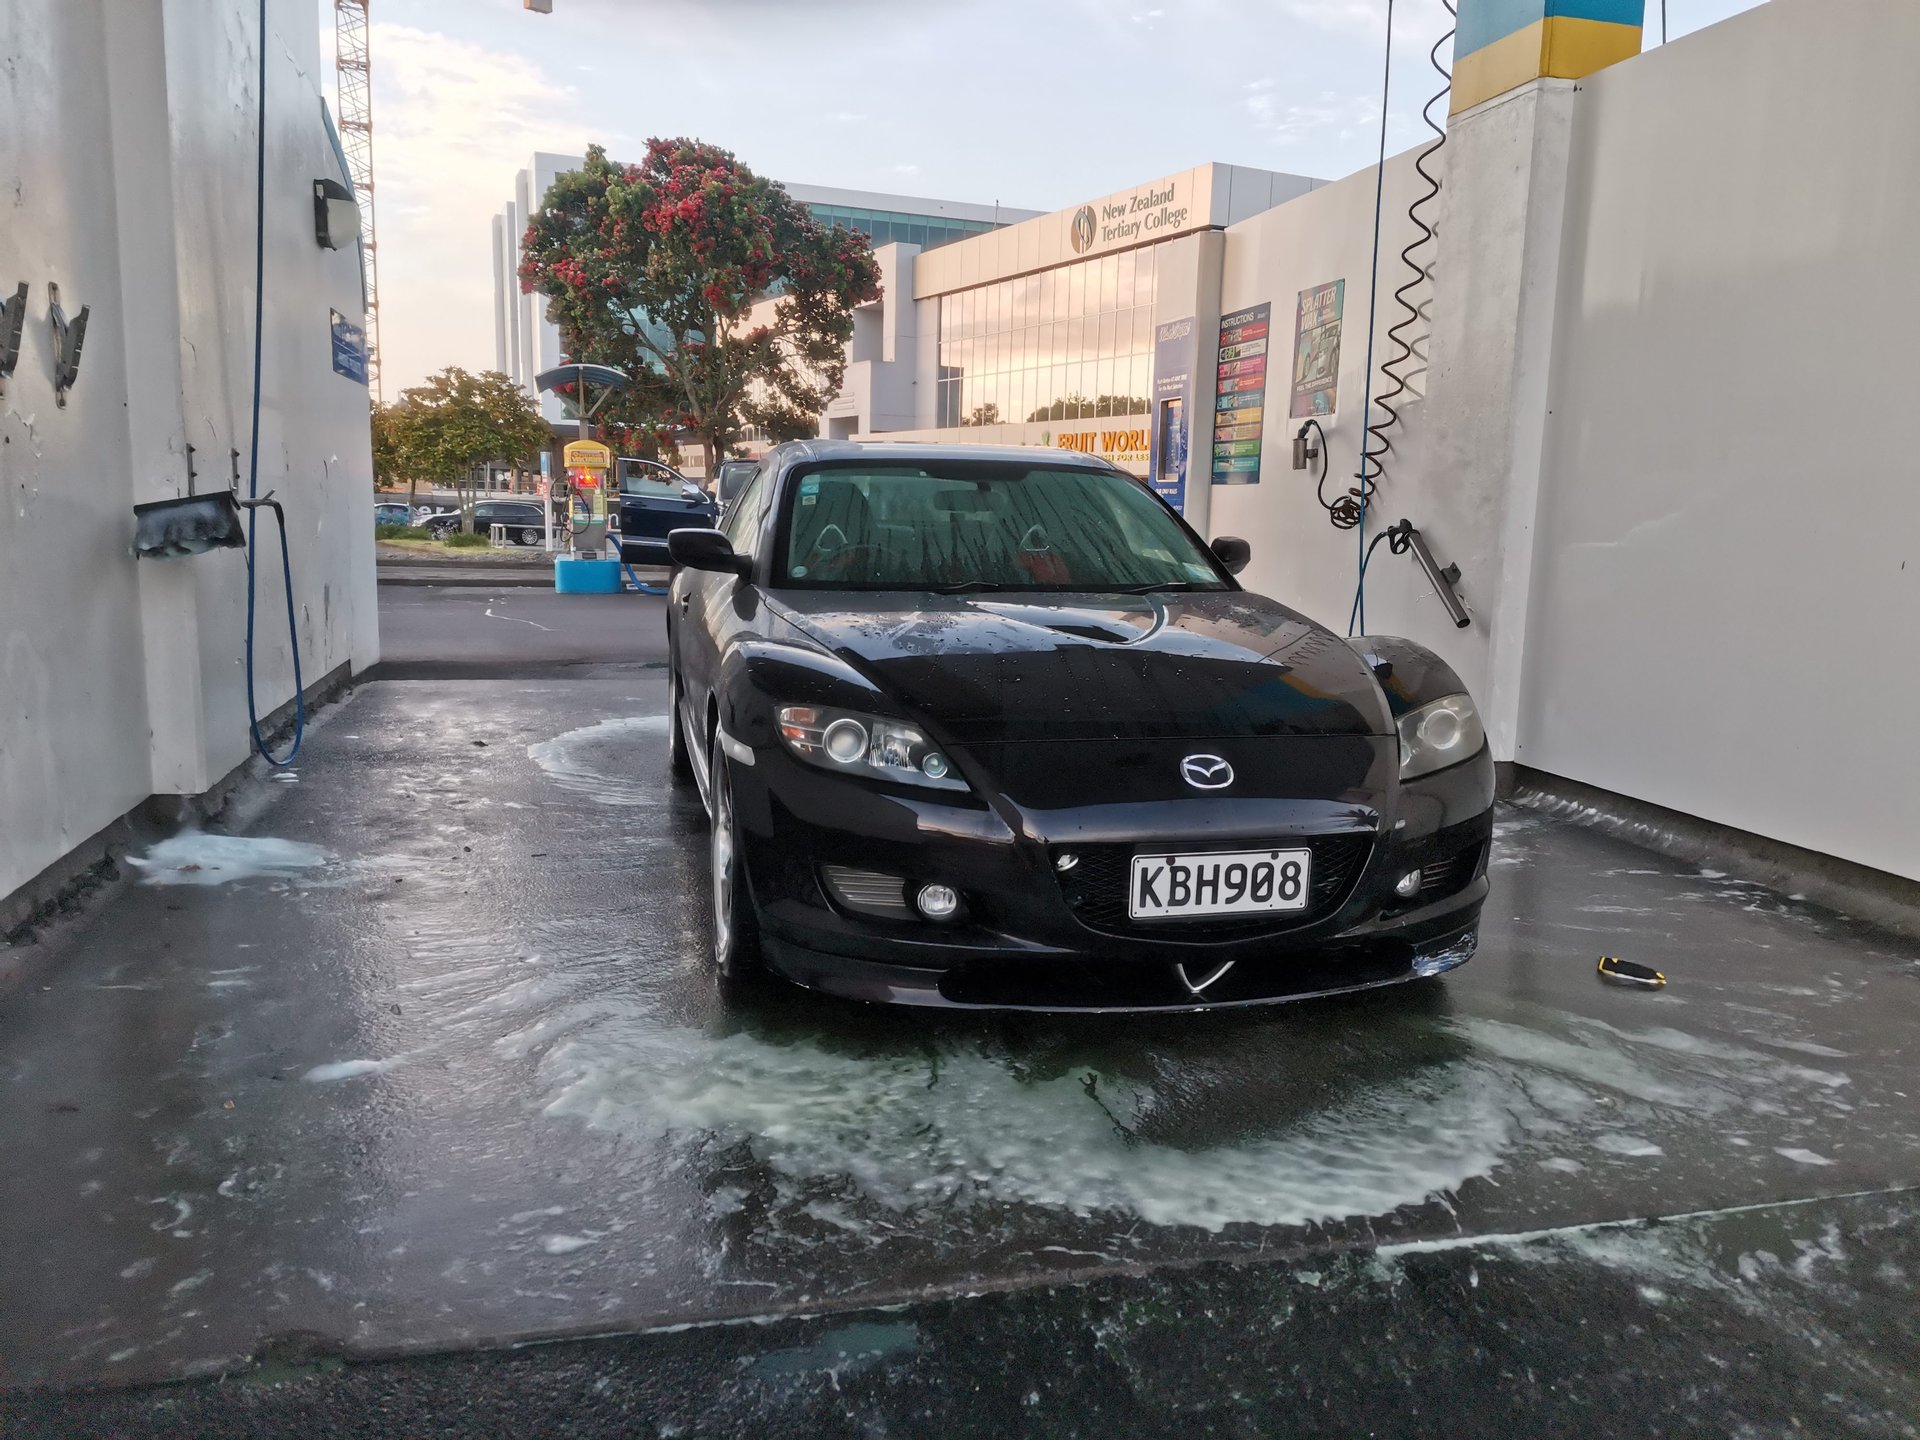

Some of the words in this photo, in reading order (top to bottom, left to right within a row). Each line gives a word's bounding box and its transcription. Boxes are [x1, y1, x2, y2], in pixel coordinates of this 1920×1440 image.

[1102, 203, 1127, 222] New
[1129, 182, 1175, 214] Zealand
[1101, 219, 1142, 242] Tertiary
[1144, 206, 1188, 229] College
[1301, 286, 1337, 315] SPLATTER
[1221, 311, 1255, 329] INSTRUCTIONS
[1301, 310, 1319, 331] WAX
[1057, 431, 1097, 453] FRUIT
[1101, 429, 1151, 453] WORL
[1117, 453, 1133, 462] FOR
[1139, 860, 1302, 908] KBH908
